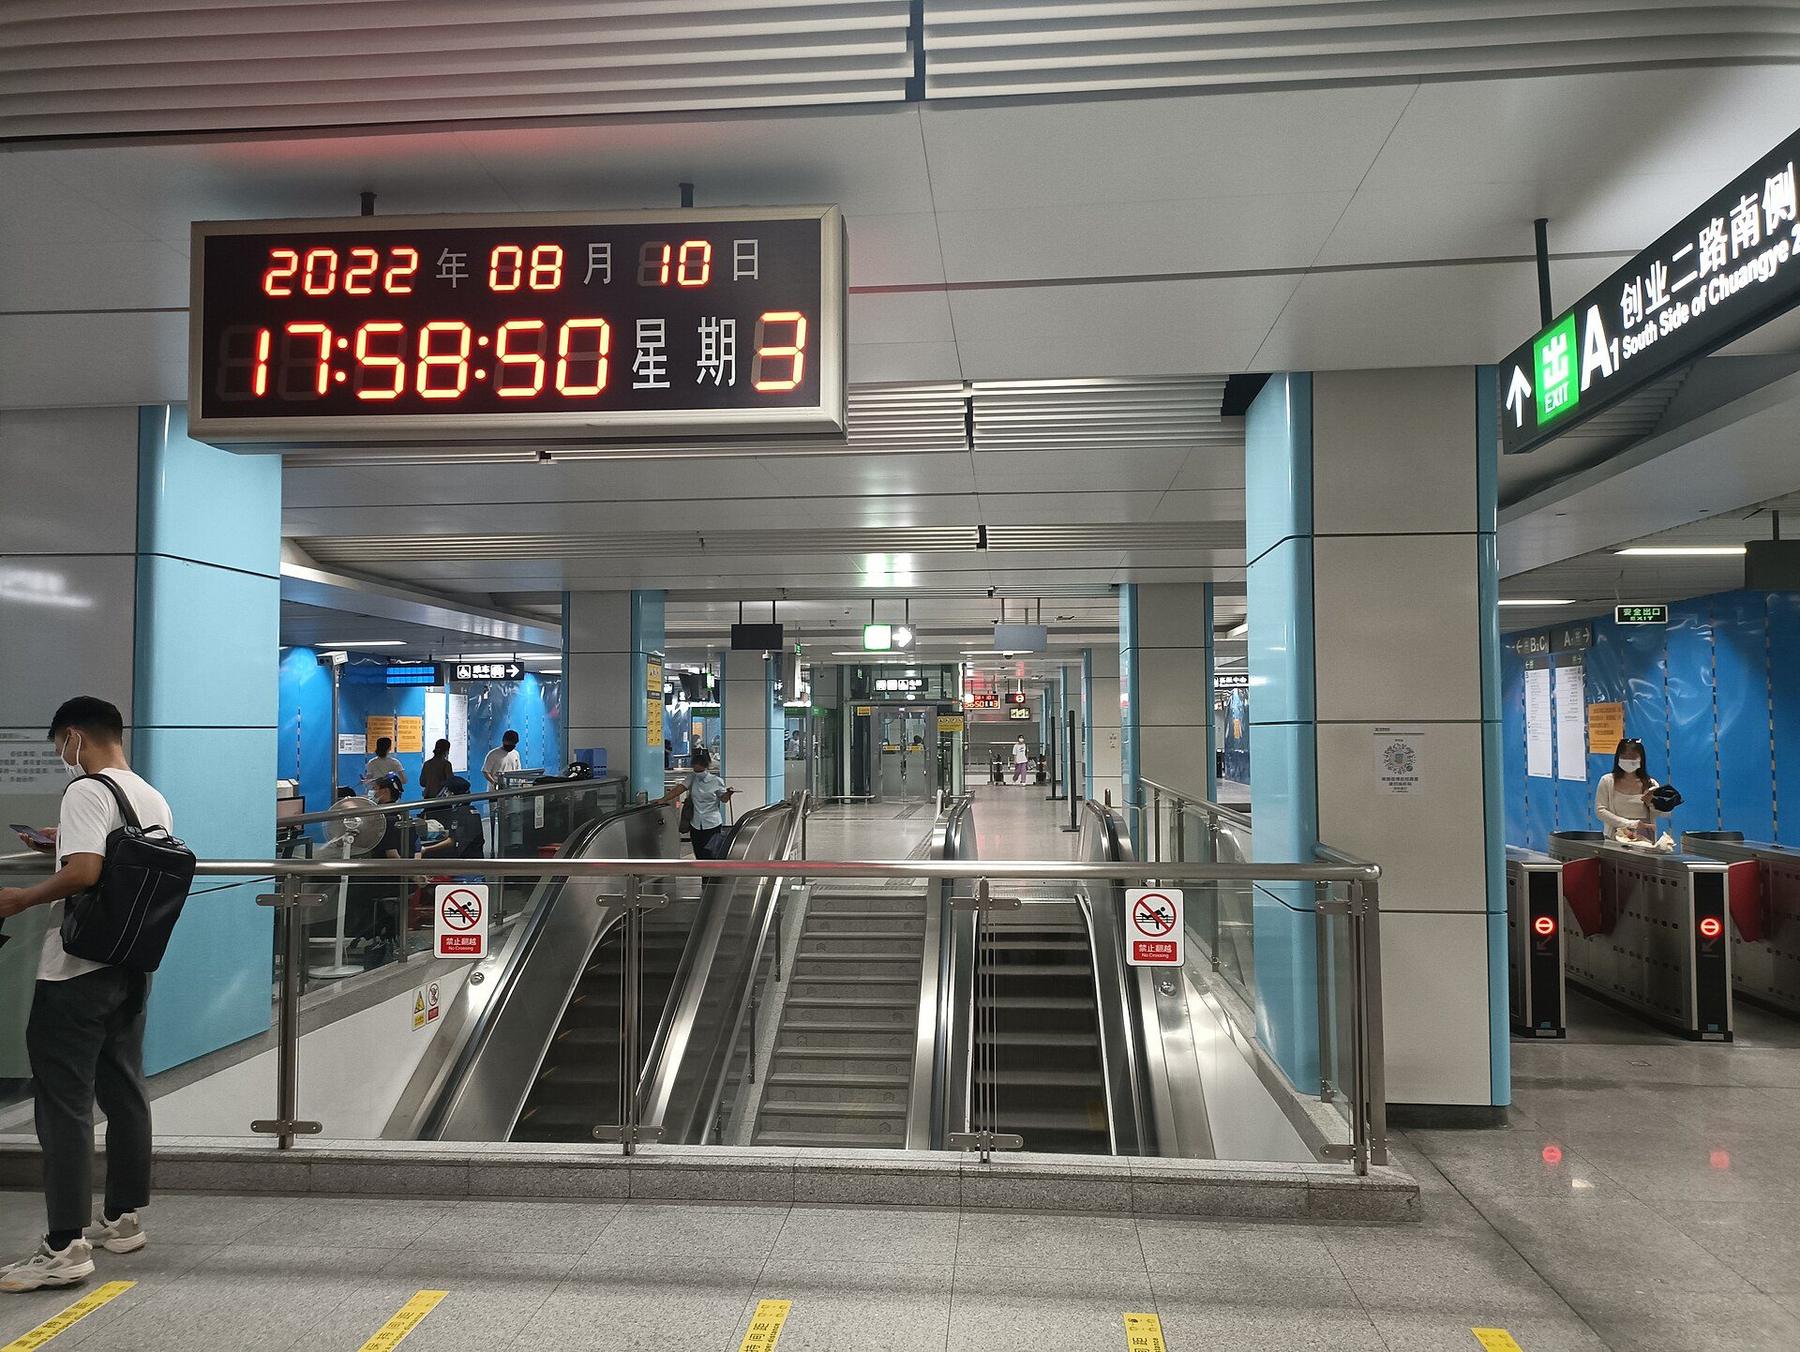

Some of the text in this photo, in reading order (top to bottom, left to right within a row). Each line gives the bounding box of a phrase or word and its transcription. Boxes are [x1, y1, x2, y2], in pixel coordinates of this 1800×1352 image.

[262, 238, 759, 296] 2022 年 08 月 10 日
[1620, 161, 1796, 330] 创业二路南侧
[1622, 319, 1658, 360] South
[1659, 301, 1690, 337] Side
[1691, 284, 1707, 317] of
[1708, 239, 1790, 306] Chuangye
[252, 316, 611, 401] 17:58:50
[752, 310, 808, 393] 3
[1541, 332, 1569, 391] 出
[1544, 380, 1569, 414] EXIT
[1623, 607, 1661, 616] 安全出口
[1138, 944, 1172, 953] 禁止翻越
